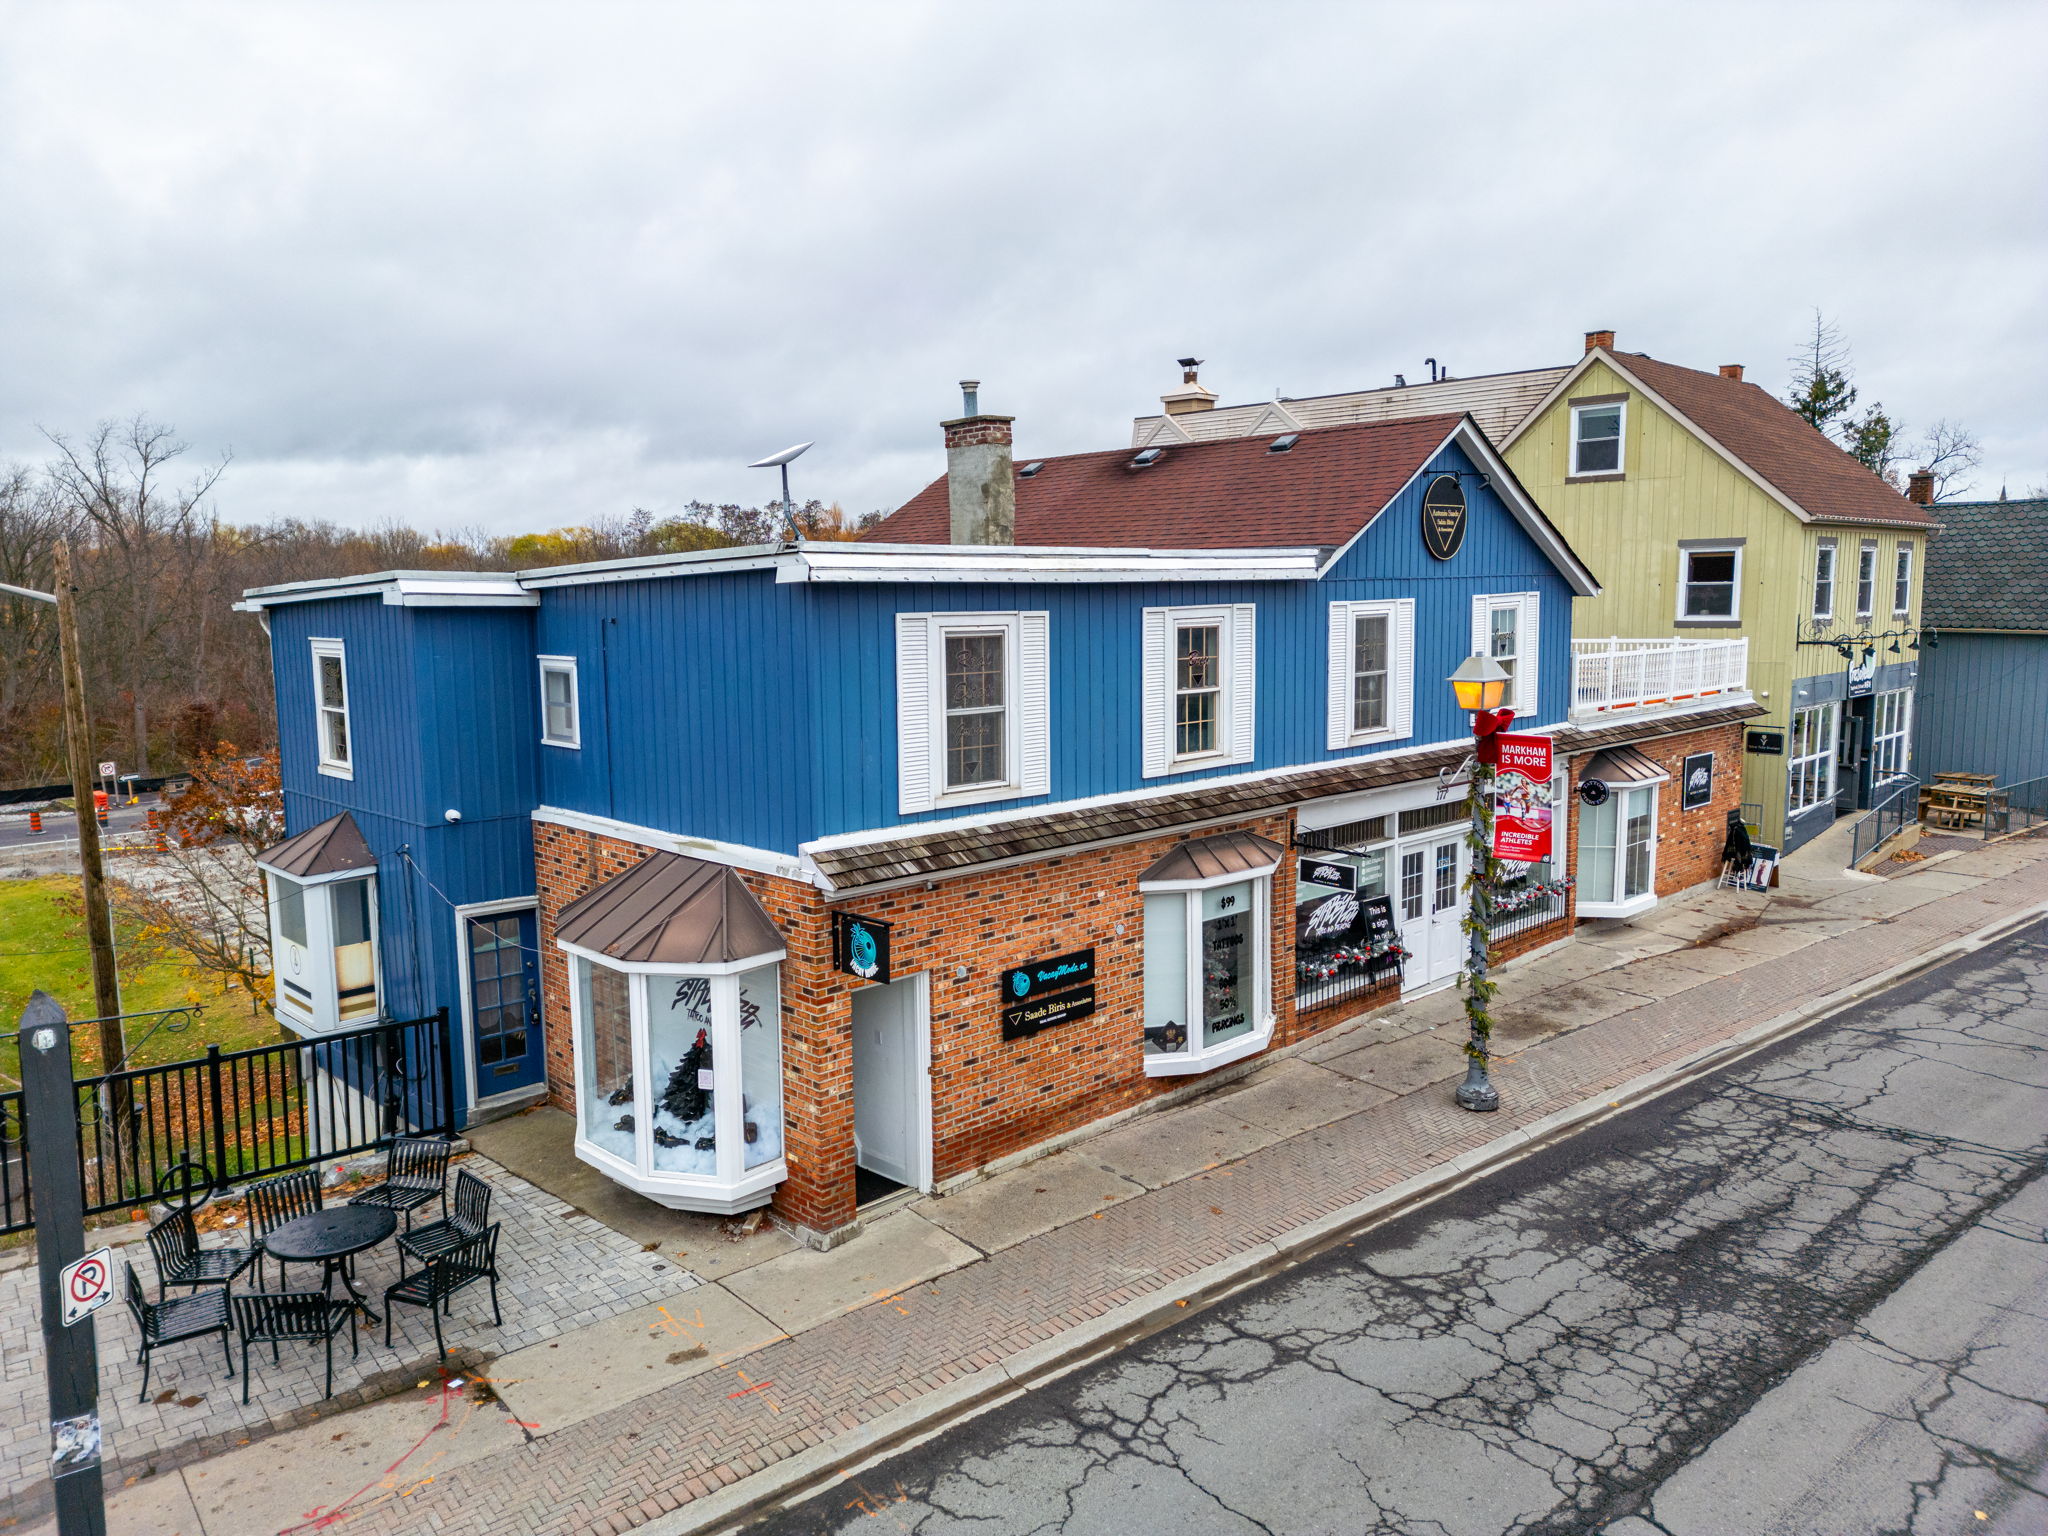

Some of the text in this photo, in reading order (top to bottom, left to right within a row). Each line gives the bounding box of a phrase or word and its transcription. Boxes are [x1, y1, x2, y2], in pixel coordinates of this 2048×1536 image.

[1501, 744, 1547, 757] MARKHAM
[1501, 754, 1547, 768] IS MORE
[1436, 789, 1449, 801] 177
[1500, 837, 1533, 846] ATHLETES
[1501, 831, 1540, 841] INCREDIBLE
[1220, 895, 1236, 910] $99
[1368, 904, 1387, 916] This is
[1376, 918, 1389, 928] sign
[1212, 933, 1244, 952] TATTOOS
[1037, 962, 1088, 982] VacayMode.ca
[1024, 1007, 1047, 1022] Saade
[1048, 1001, 1066, 1015] Biris
[1211, 1012, 1245, 1034] PIERCINGS
